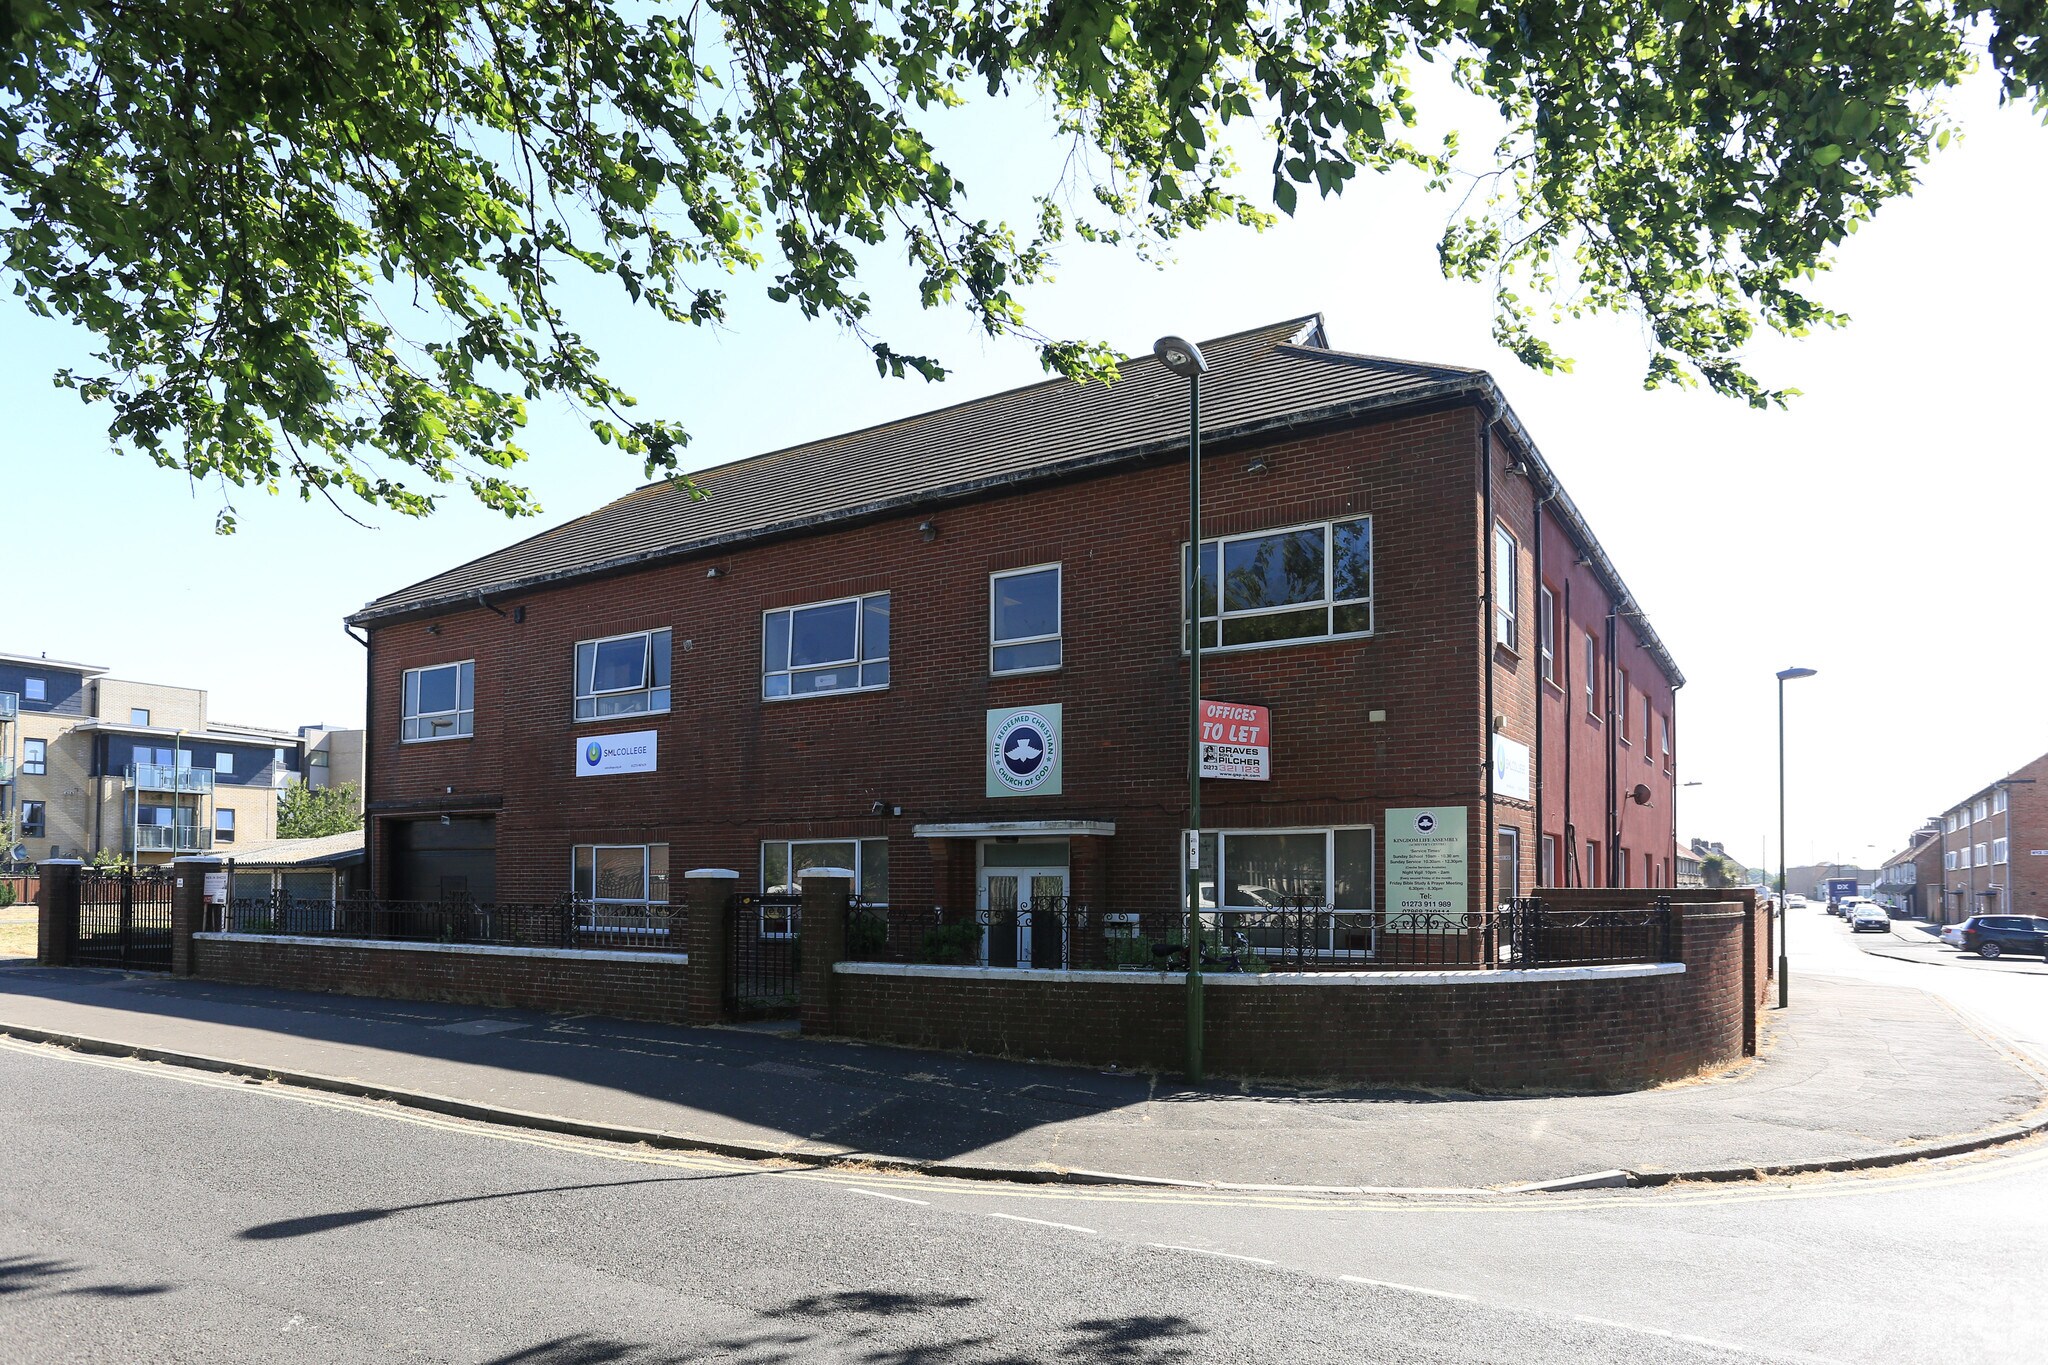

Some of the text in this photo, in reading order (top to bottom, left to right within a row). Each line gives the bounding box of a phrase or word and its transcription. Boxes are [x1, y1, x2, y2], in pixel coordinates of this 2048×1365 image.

[1207, 705, 1256, 721] OFFICES
[998, 716, 1030, 740] REDEEMED
[1032, 717, 1054, 755] CHRISTIAN
[1203, 722, 1260, 744] TO LET
[604, 746, 647, 757] SMLCOLLEGE
[1218, 746, 1258, 755] GRAVES
[1219, 757, 1260, 766] PILCHER
[998, 768, 1022, 786] CHURCH
[1035, 765, 1049, 781] GOD
